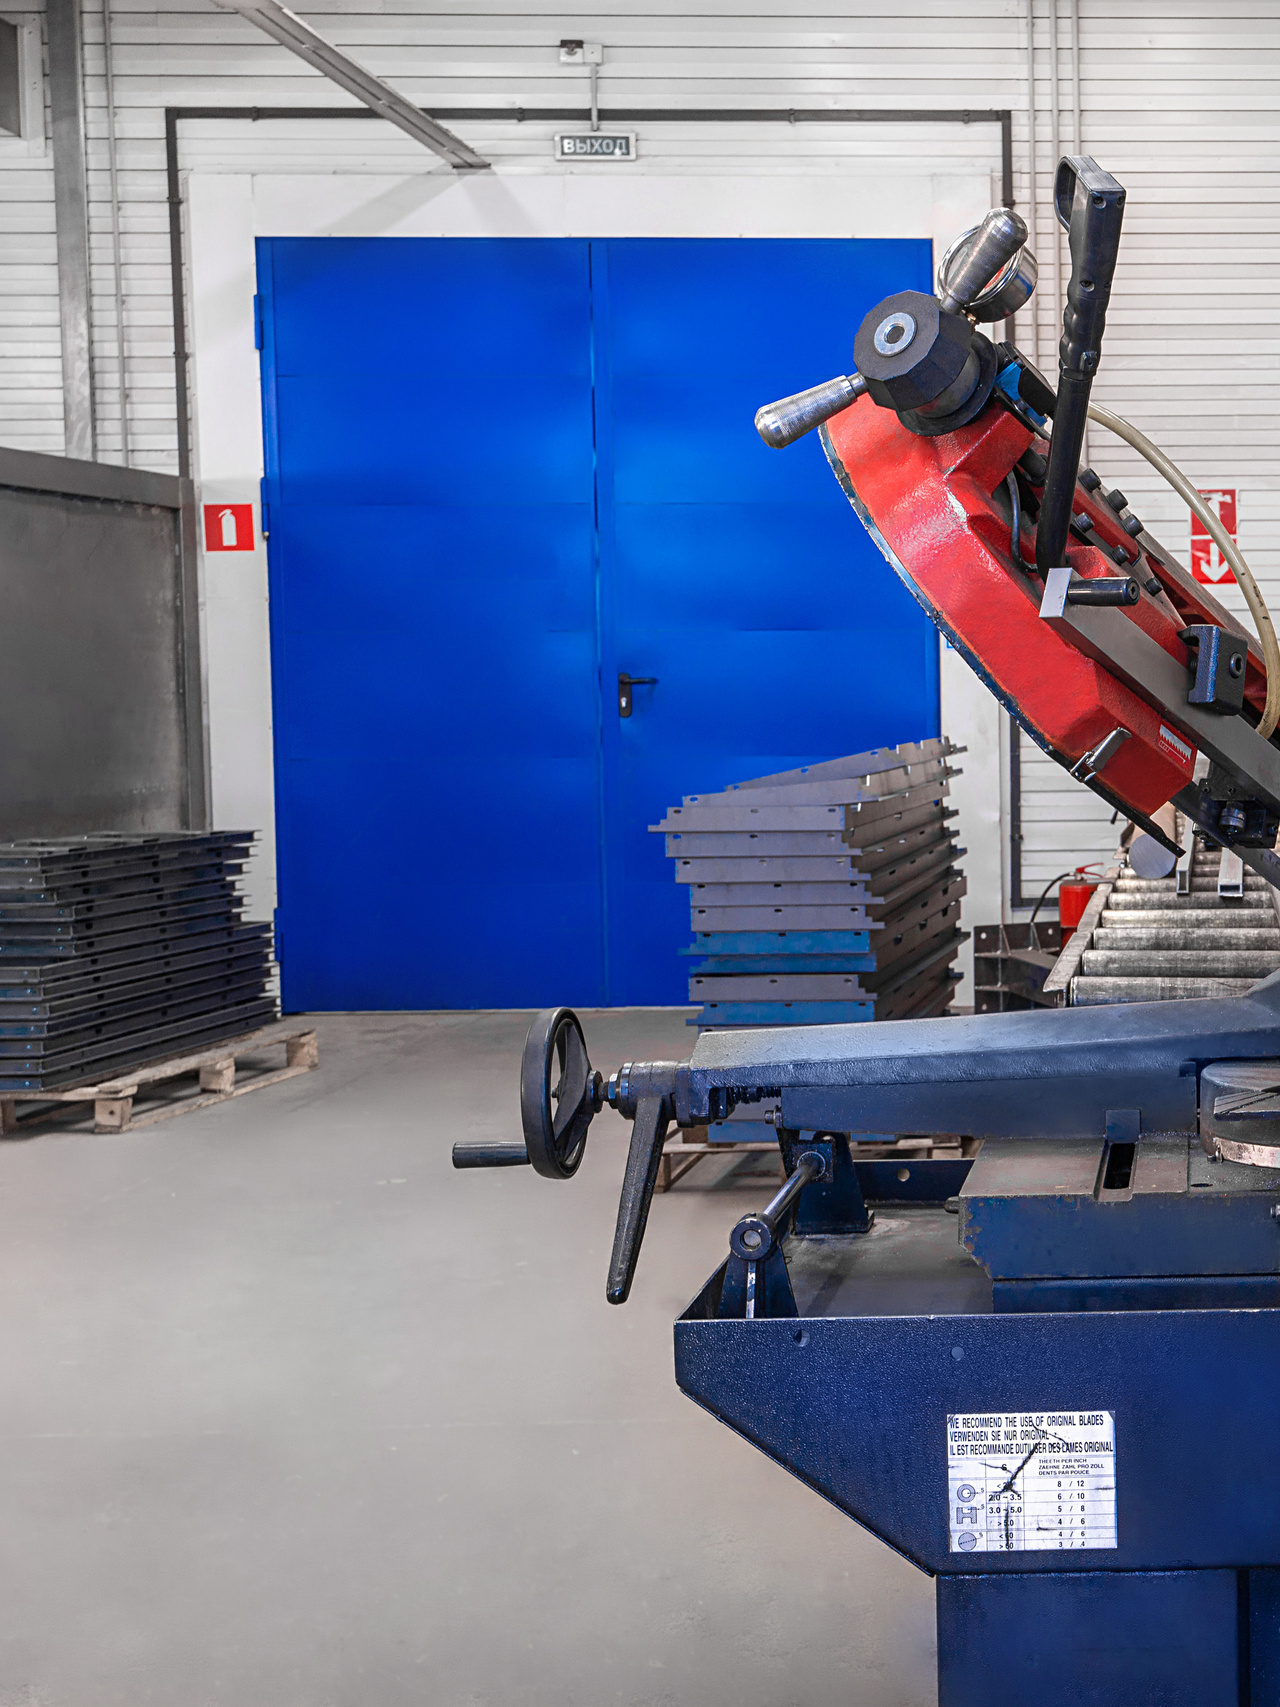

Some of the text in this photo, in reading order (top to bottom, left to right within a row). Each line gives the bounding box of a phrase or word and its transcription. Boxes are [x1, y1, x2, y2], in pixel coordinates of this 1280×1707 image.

[562, 139, 628, 155] ВЫХОД
[950, 1414, 1104, 1429] WE RECOMMEND THE USE OF ORIGINAL BLADES
[950, 1429, 1049, 1442] VERWENDEN SIE NUR ORIGINAL
[950, 1444, 956, 1456] IL
[957, 1444, 969, 1456] EST
[970, 1443, 1014, 1455] RECOMMANDE
[1048, 1442, 1061, 1454] DES
[1061, 1441, 1083, 1453] LAMES
[1084, 1441, 1113, 1453] ORIGINAL
[1057, 1480, 1062, 1488] 8
[1077, 1492, 1085, 1500] 10
[989, 1506, 1001, 1514] 3.0
[1057, 1505, 1062, 1513] 5
[1080, 1517, 1086, 1525] 6
[1005, 1531, 1014, 1539] 0
